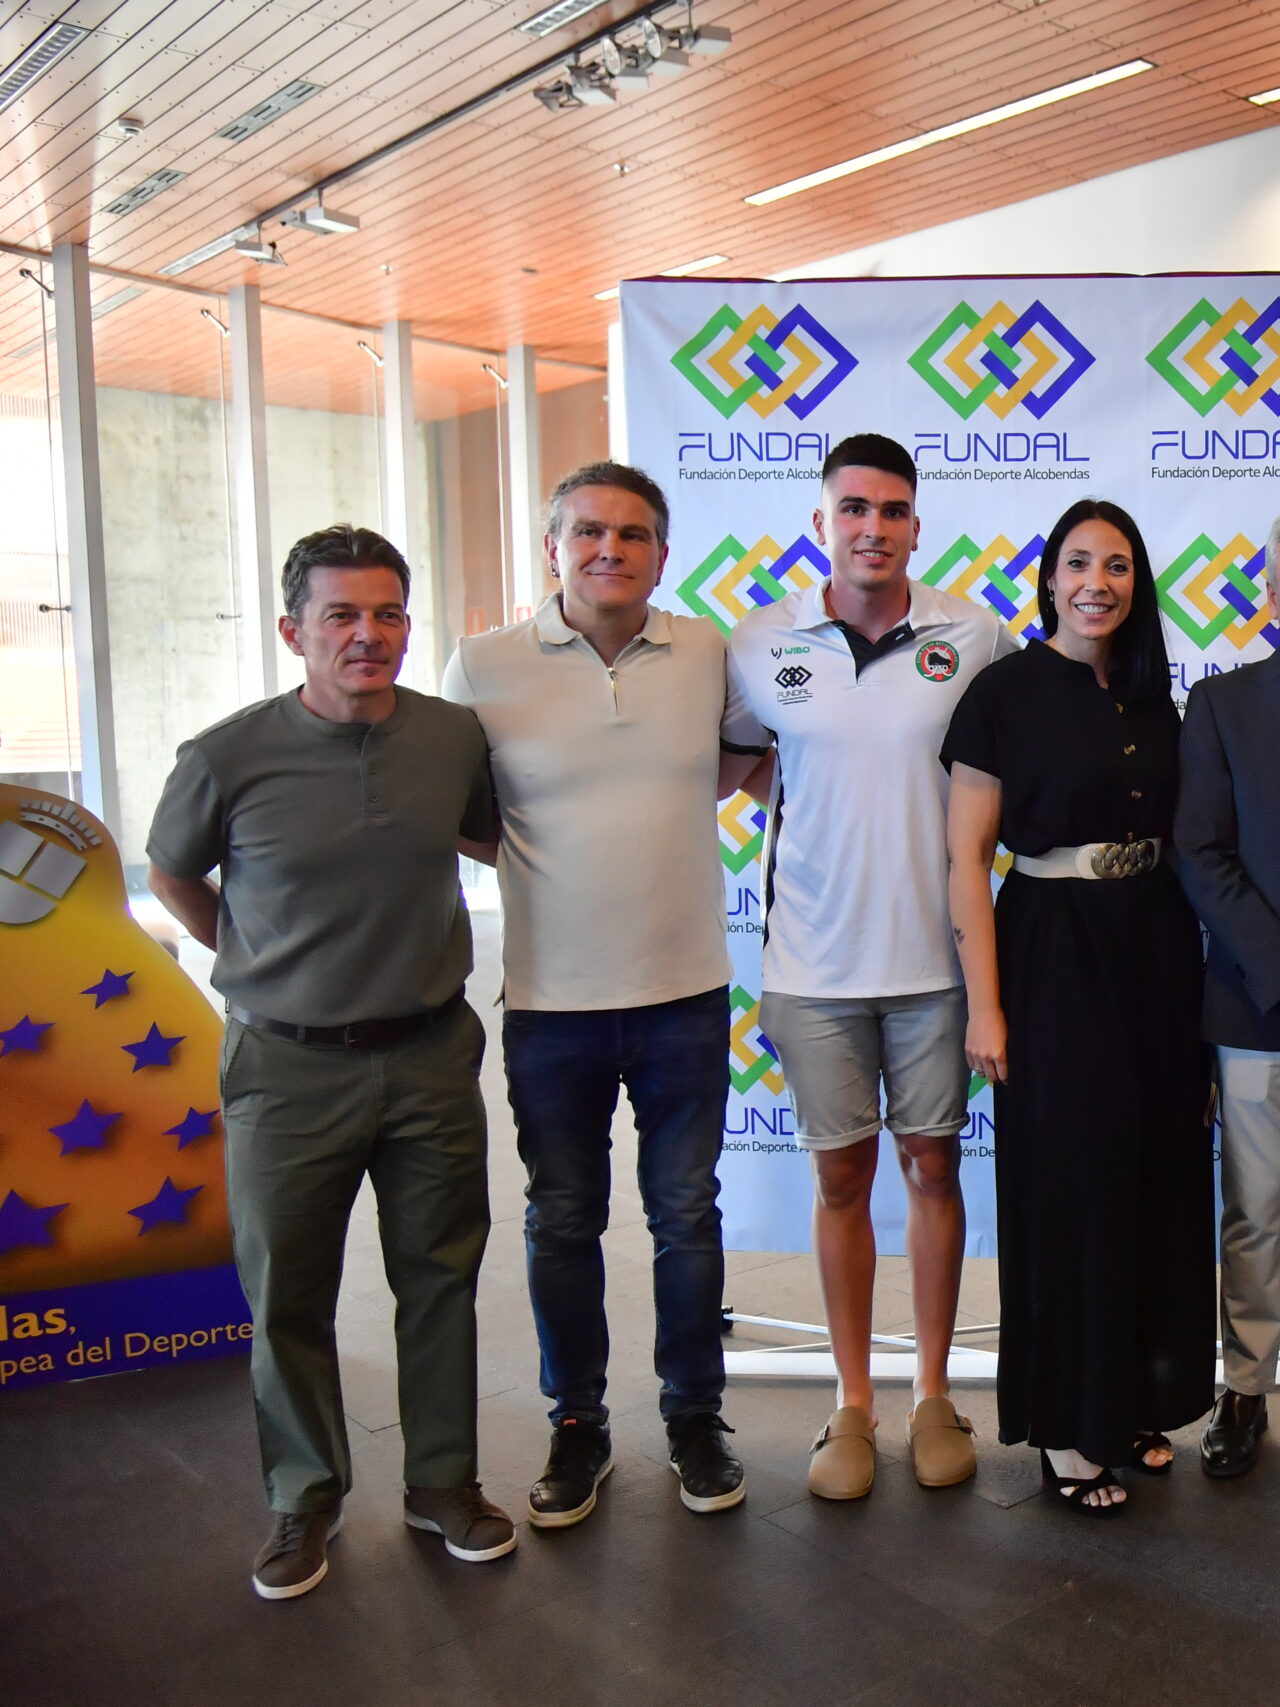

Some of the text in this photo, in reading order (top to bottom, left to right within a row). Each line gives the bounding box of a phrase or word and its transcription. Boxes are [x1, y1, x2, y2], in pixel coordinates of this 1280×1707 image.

[914, 432, 1090, 462] FUNDAL
[679, 468, 823, 482] Fundación Deporte Alcobe
[974, 468, 1022, 483] Deporte
[1024, 468, 1090, 481] Alcobendas
[1152, 466, 1209, 478] Fundación
[1212, 466, 1260, 480] Deporte
[784, 646, 811, 655] WIBO
[777, 688, 813, 700] FUNDAL
[724, 1107, 795, 1135] UND
[722, 1141, 750, 1152] ación
[752, 1141, 797, 1155] Deporte
[66, 1336, 112, 1366] del
[124, 1321, 254, 1358] Deporte
